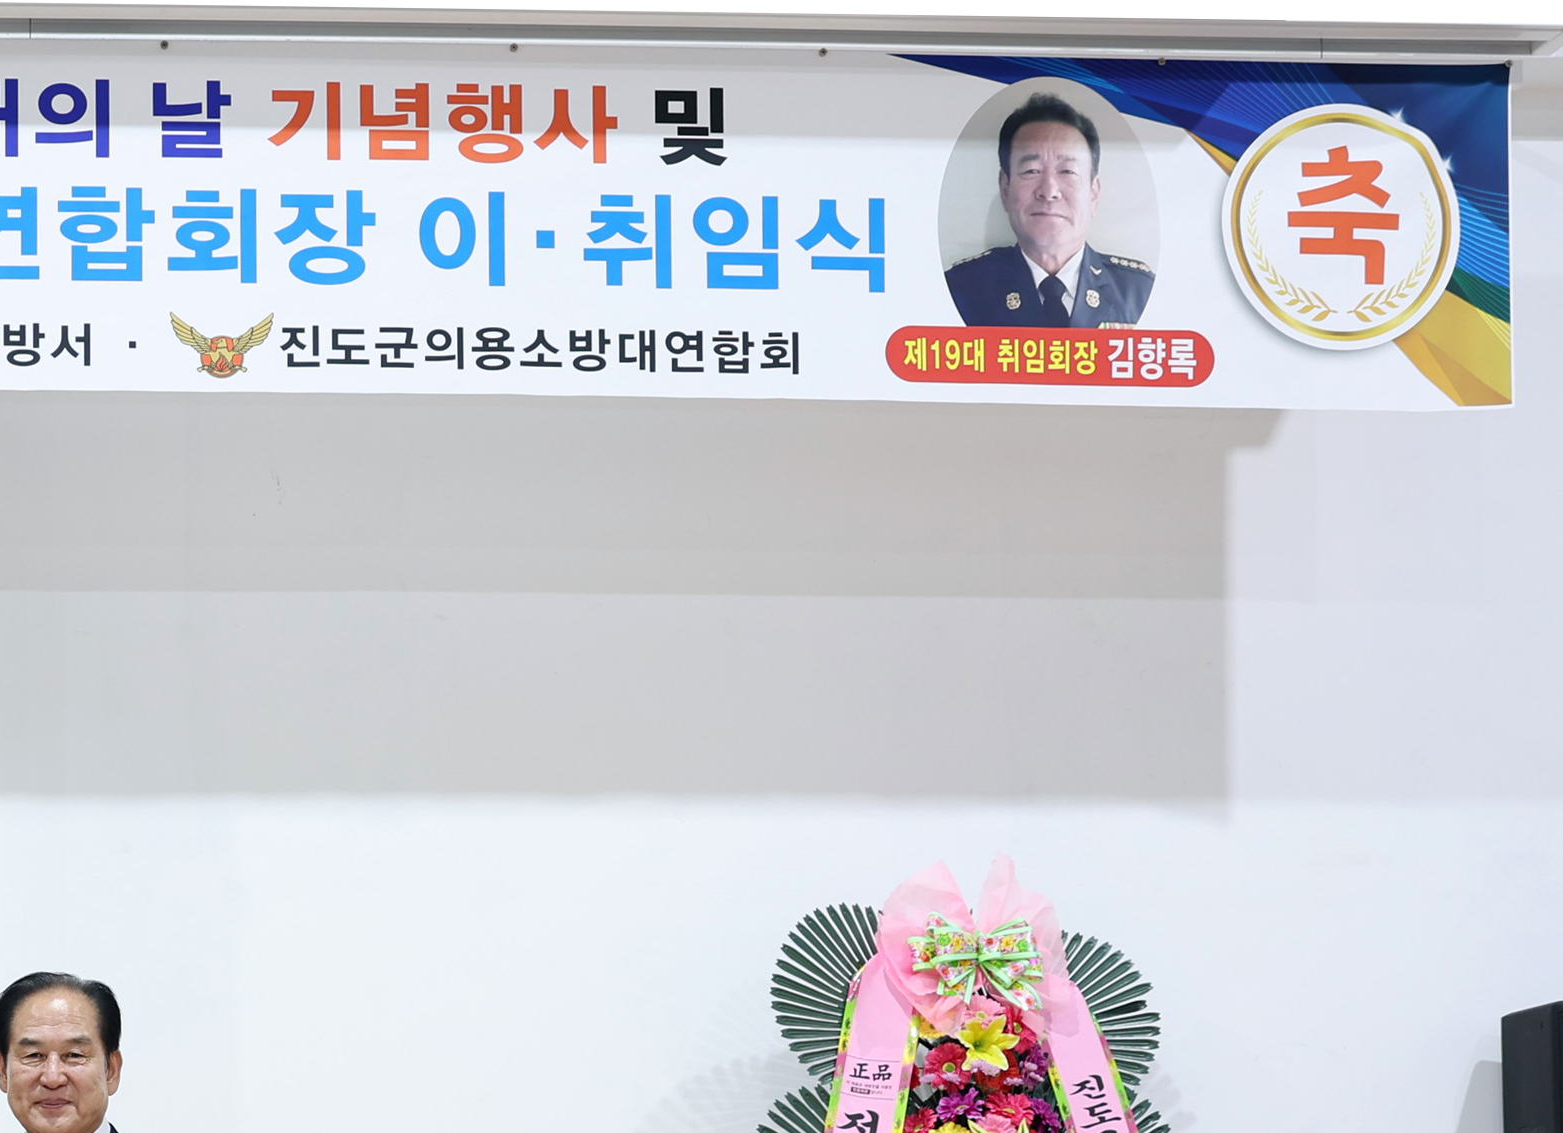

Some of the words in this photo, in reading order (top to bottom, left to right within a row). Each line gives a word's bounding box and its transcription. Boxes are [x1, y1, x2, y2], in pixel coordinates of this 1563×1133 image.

[152, 80, 232, 158] 날
[267, 81, 618, 163] 기념행사
[654, 87, 727, 166] 및
[1287, 146, 1400, 286] 축
[279, 325, 800, 375] 진도군의용소방대연합회
[903, 335, 986, 374] 제19대
[996, 336, 1099, 377] 취임회장
[1106, 336, 1198, 381] 김향록
[849, 1063, 893, 1082] 正品
